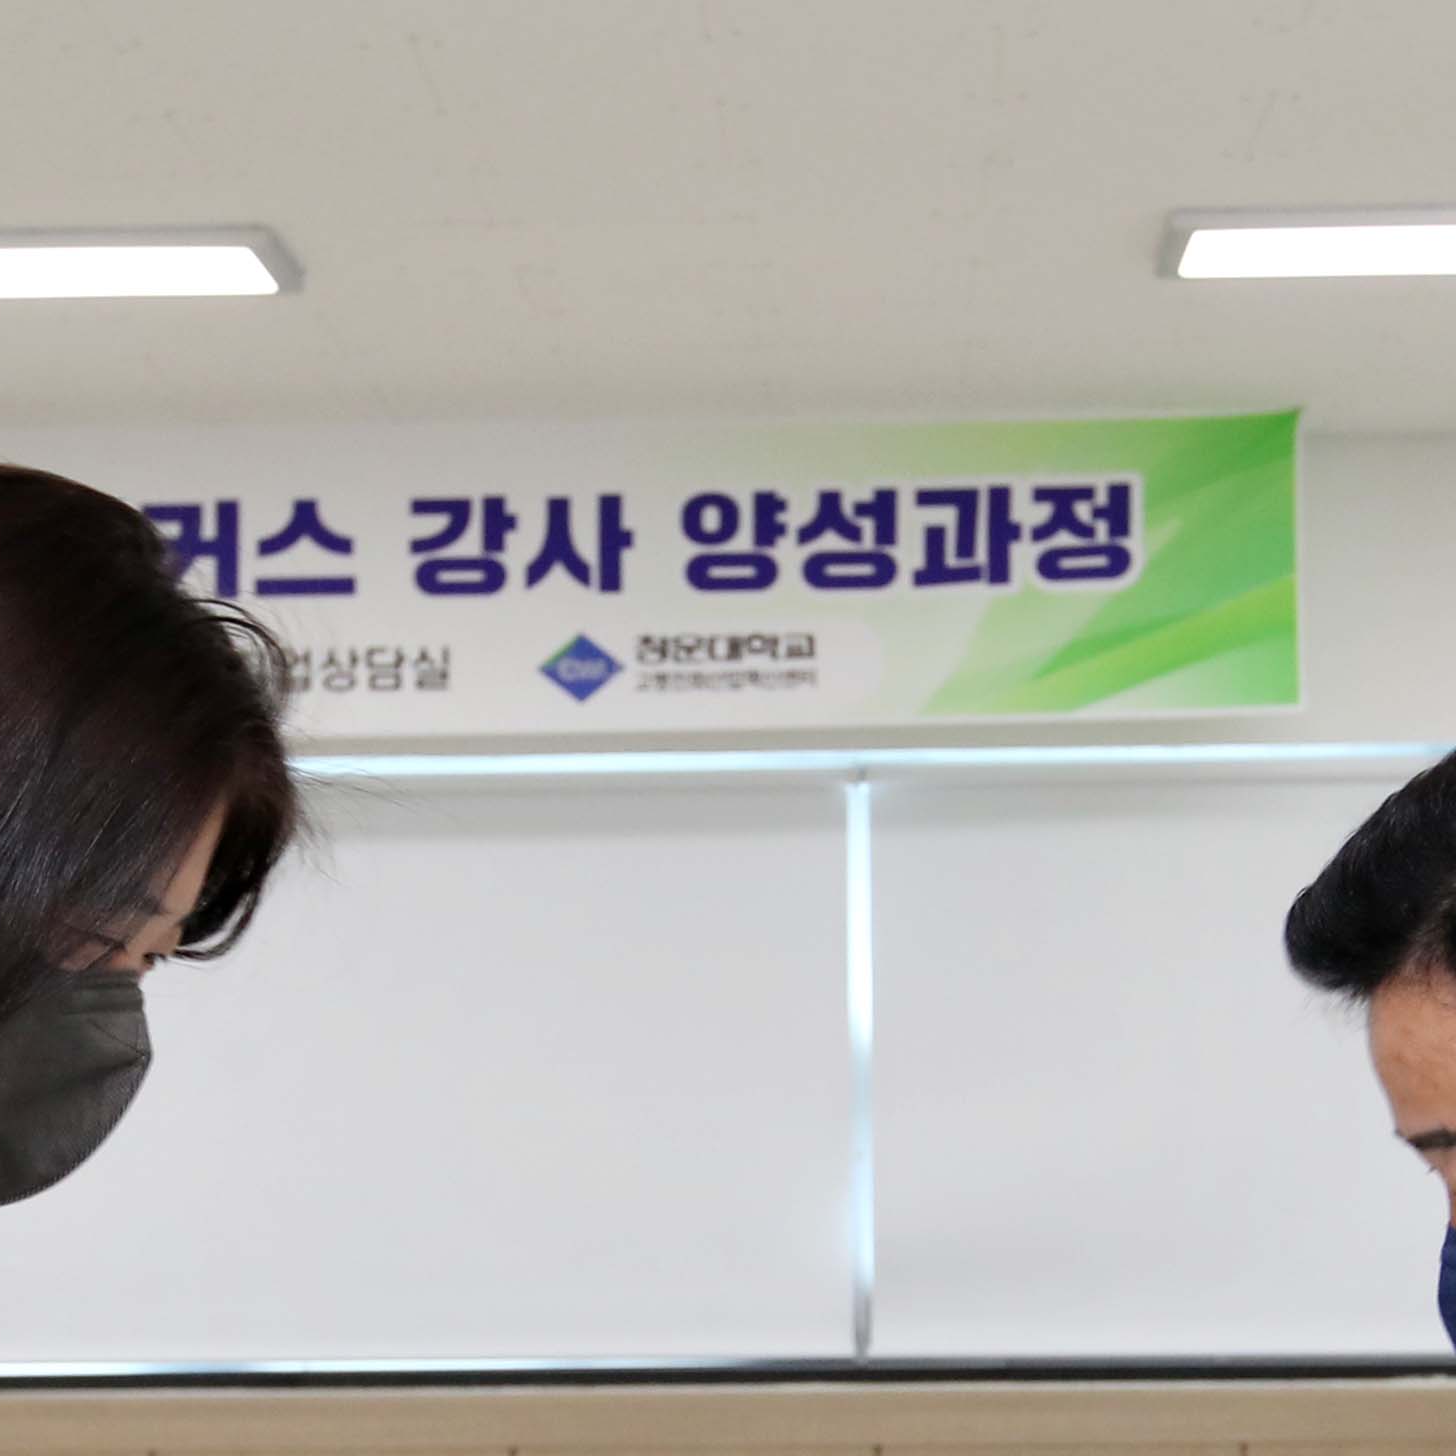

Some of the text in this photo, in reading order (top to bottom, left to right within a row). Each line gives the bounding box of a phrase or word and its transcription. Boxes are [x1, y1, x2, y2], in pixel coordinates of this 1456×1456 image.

[141, 498, 356, 598] 커스
[409, 492, 634, 595] 강사
[681, 482, 1134, 593] 양성과정
[277, 643, 453, 694] 업상담실
